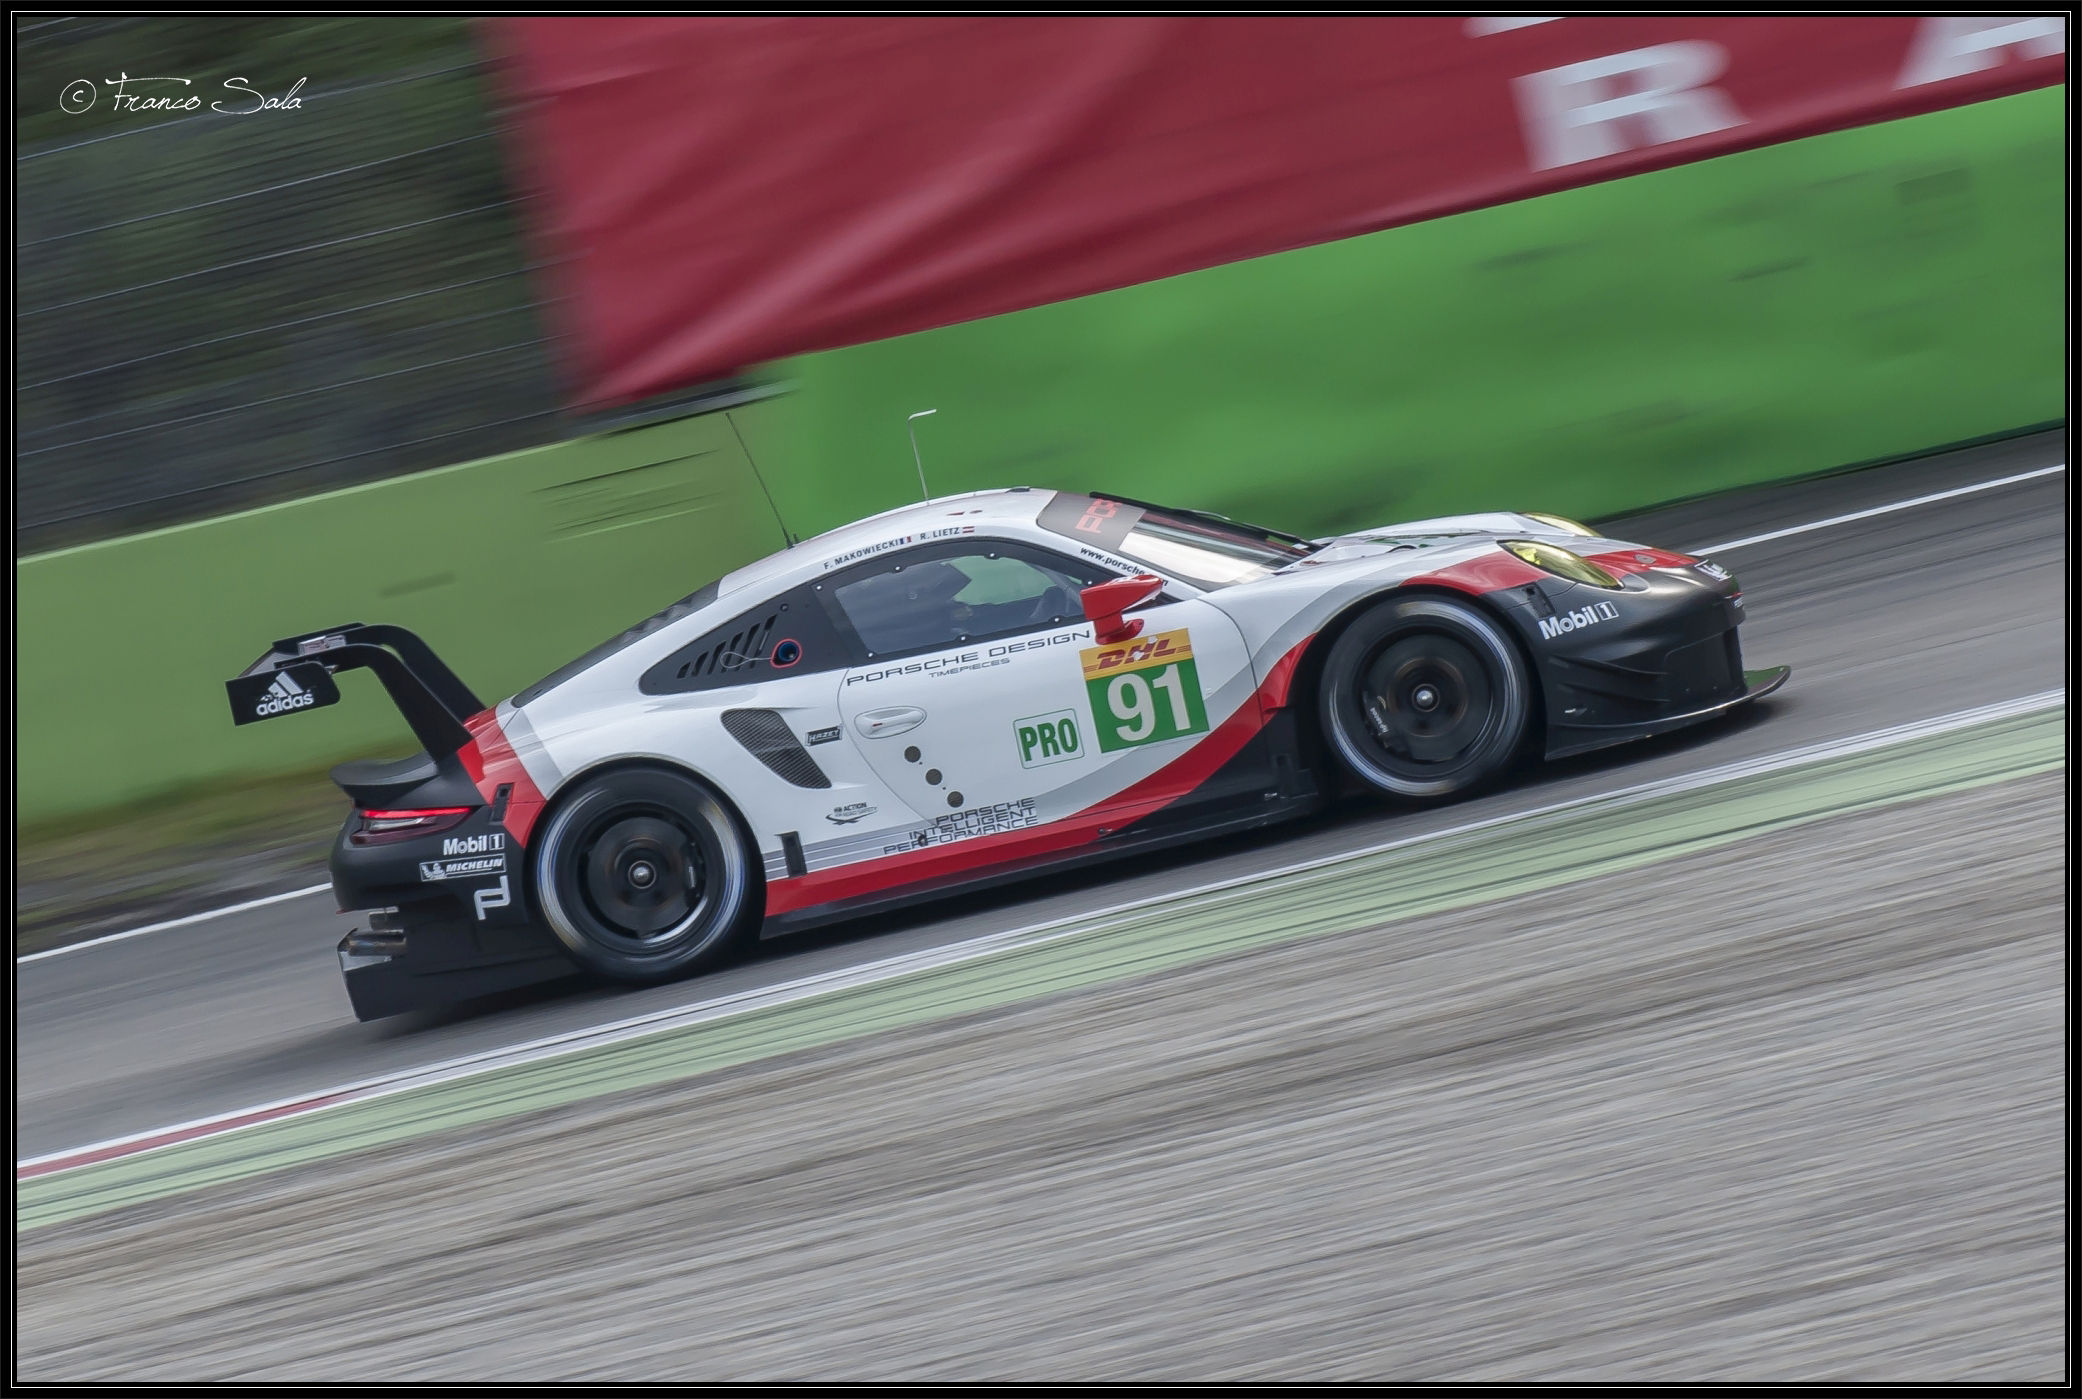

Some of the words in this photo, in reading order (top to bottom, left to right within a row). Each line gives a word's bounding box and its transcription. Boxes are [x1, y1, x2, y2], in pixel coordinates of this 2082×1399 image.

[932, 526, 960, 539] LIETZ
[834, 540, 900, 566] MAKOWIECKI
[1538, 606, 1599, 640] Mobil
[847, 651, 980, 686] PORSCHE
[989, 630, 1091, 658] DESIGN
[928, 657, 1011, 679] TIMEPIECES
[1097, 638, 1177, 670] DHL
[256, 692, 314, 716] adidas
[1107, 663, 1192, 742] 91
[1018, 717, 1079, 762] PRO
[909, 806, 1036, 841] INTELLIGENT
[936, 797, 1035, 826] PORSCHE
[443, 835, 487, 856] Mobil
[883, 815, 1039, 855] PERFORMANCE
[446, 859, 503, 873] MICHELIN
